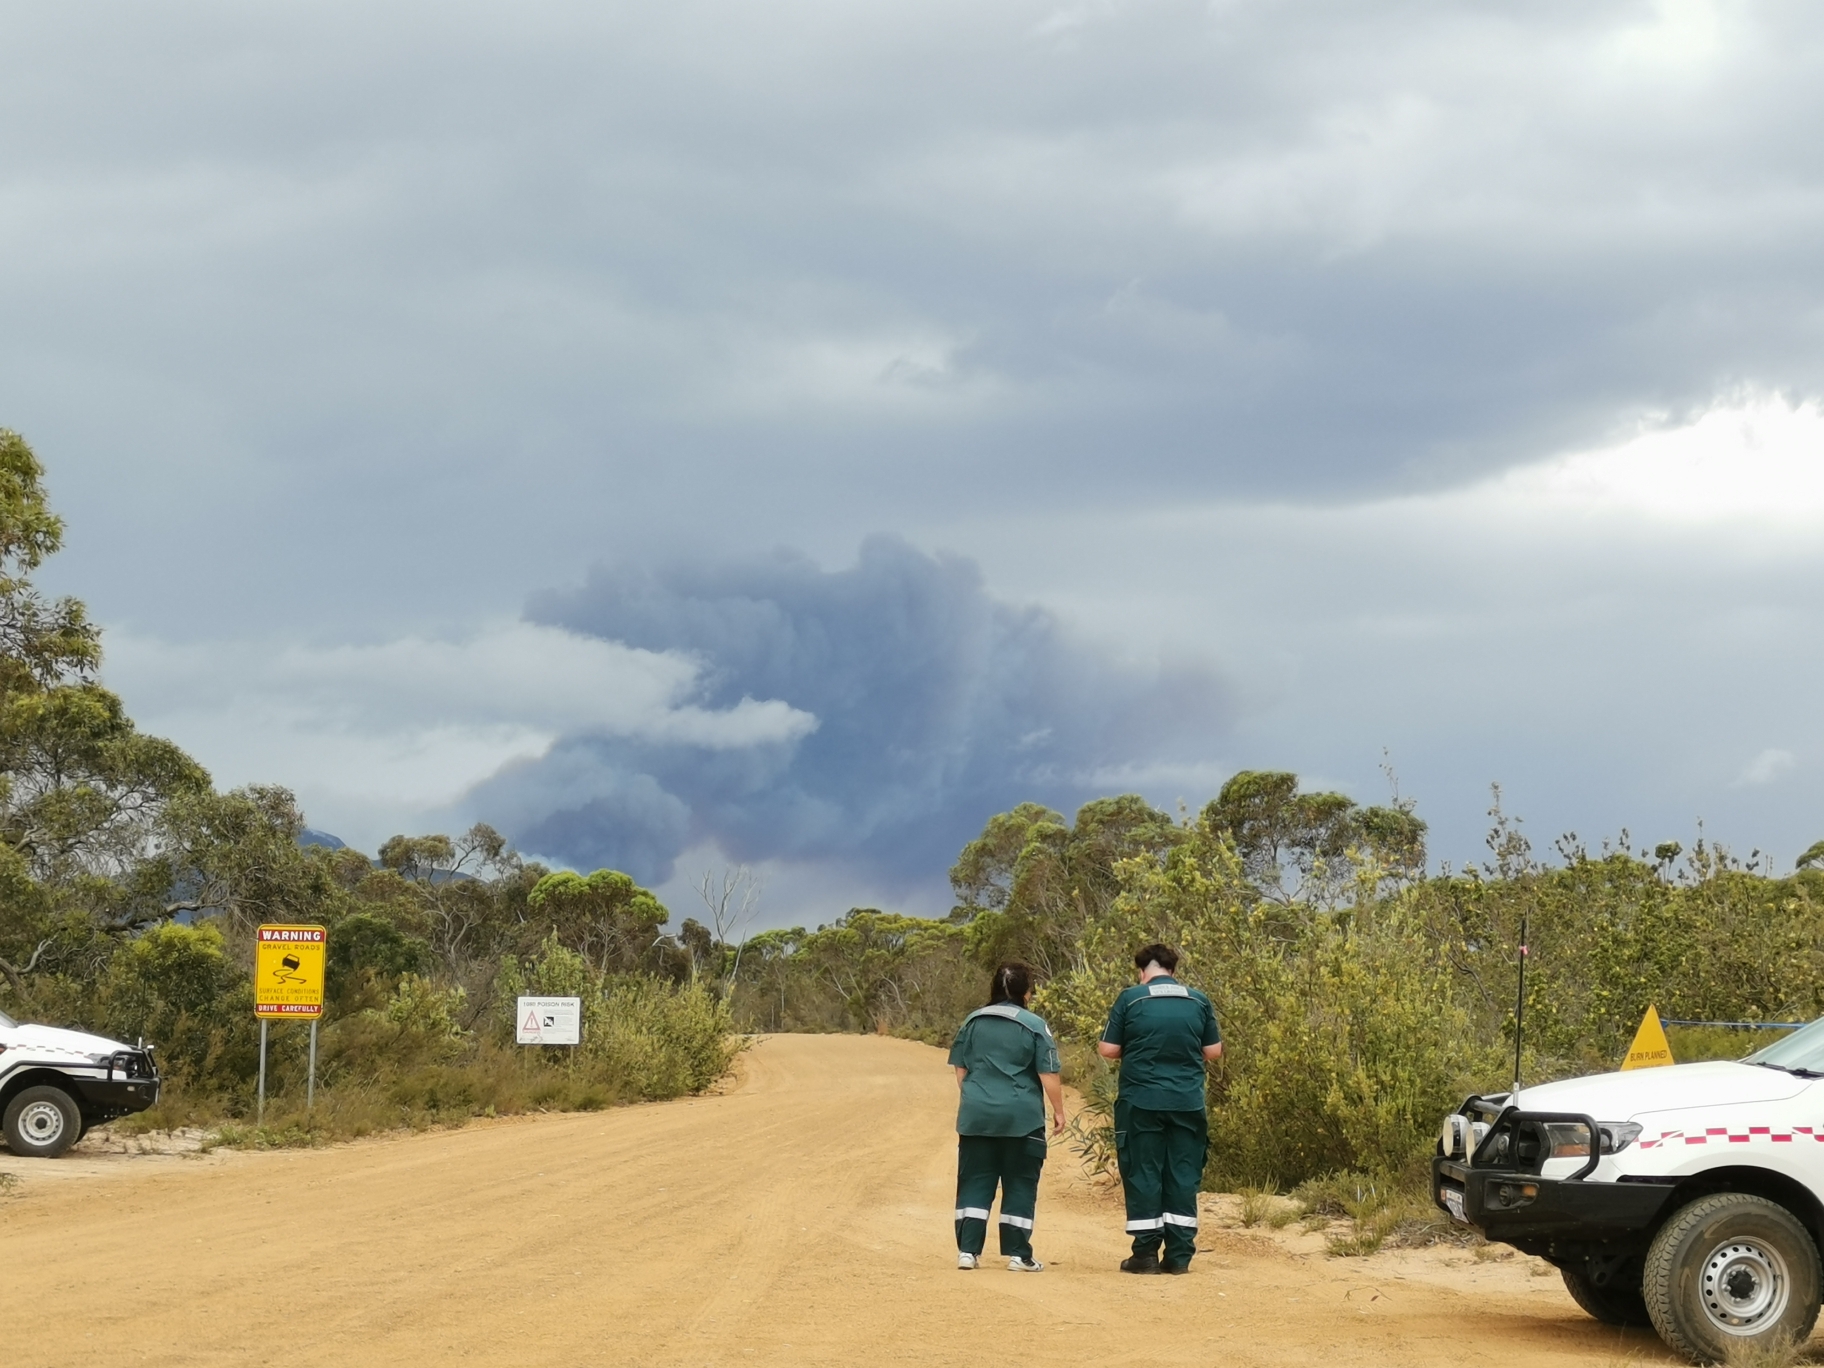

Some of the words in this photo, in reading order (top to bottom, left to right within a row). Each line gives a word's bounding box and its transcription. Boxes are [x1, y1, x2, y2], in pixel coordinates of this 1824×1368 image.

[262, 930, 321, 941] WARNING
[262, 943, 291, 951] GRAVEL
[294, 995, 319, 1003] OFTEN
[258, 1004, 278, 1012] DRIVE
[281, 1005, 318, 1013] CAREFULLY
[1630, 1052, 1645, 1062] BURN
[1644, 1049, 1668, 1061] PLANNED
